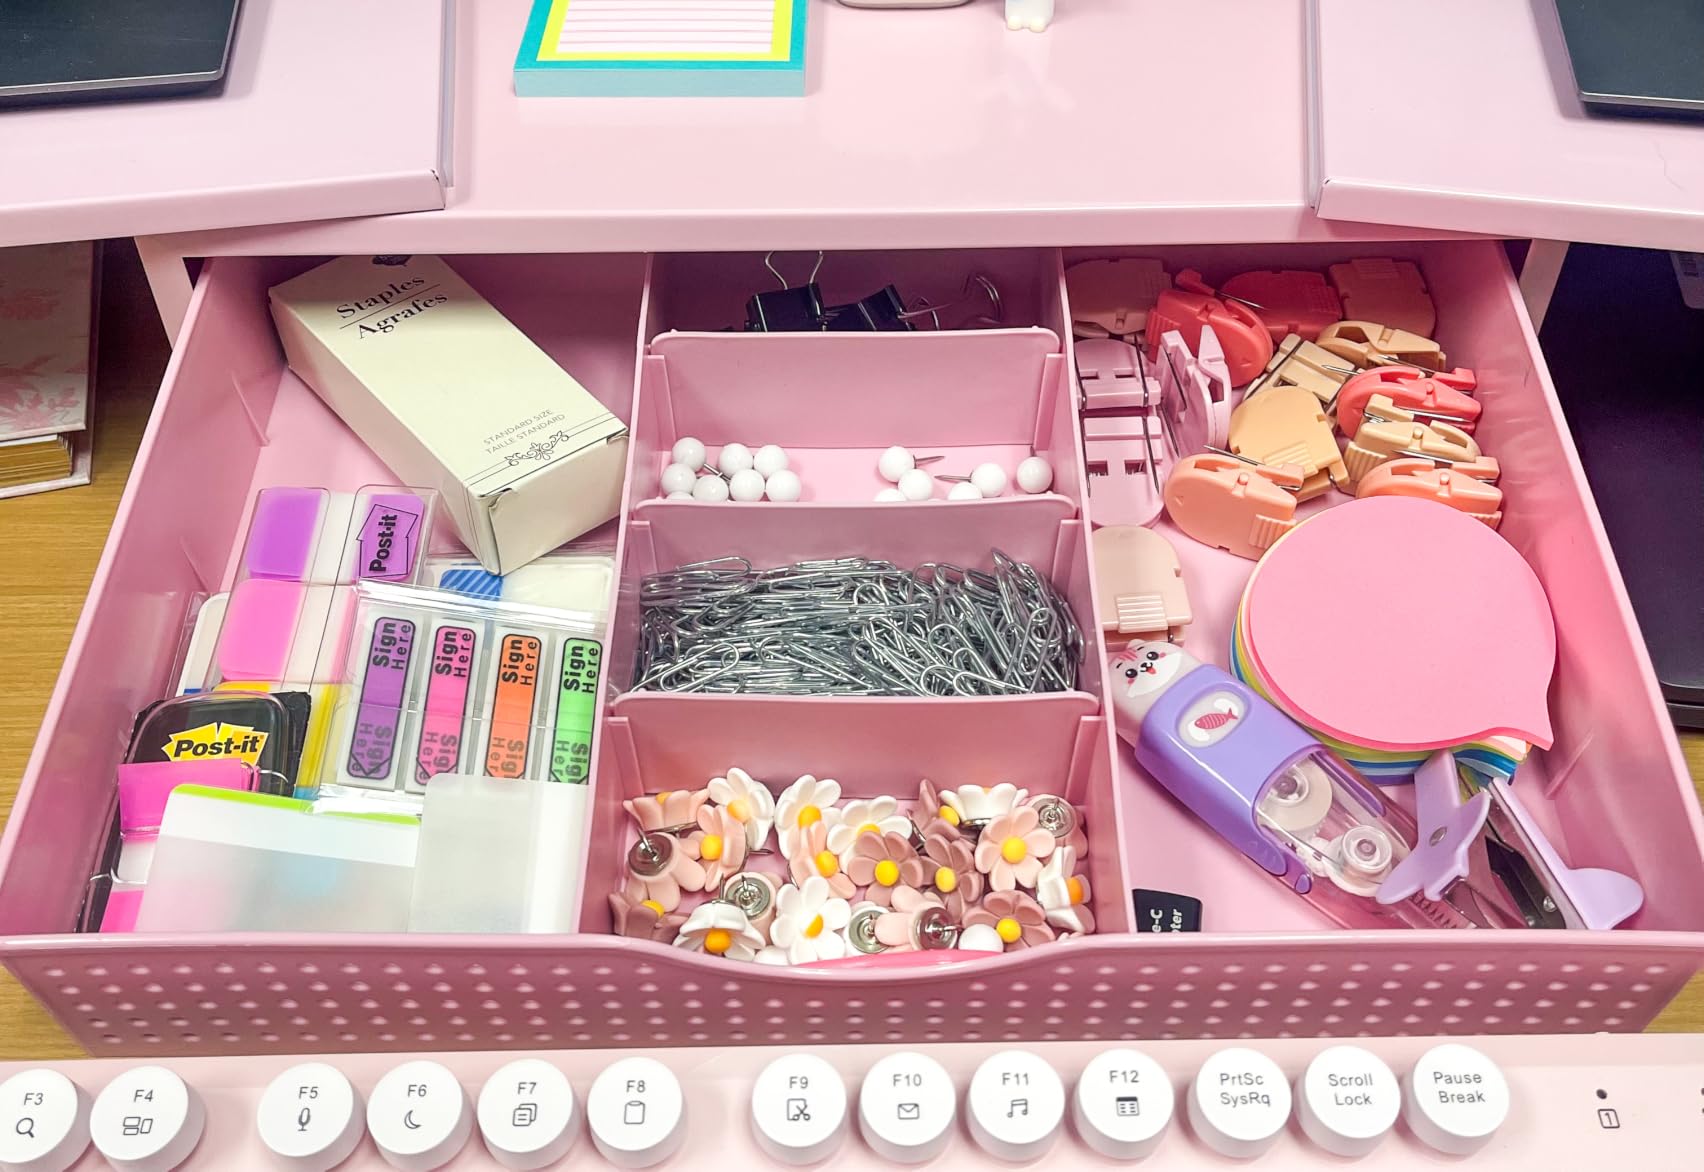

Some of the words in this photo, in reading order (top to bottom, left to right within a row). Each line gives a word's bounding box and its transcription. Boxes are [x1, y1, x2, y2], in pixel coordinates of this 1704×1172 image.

[336, 277, 425, 319] Staples
[359, 294, 448, 339] Agrafes
[483, 418, 533, 445] STANDARD
[533, 409, 553, 421] SIZE
[486, 437, 517, 454] TAILLE
[516, 413, 566, 440] STANDARD
[368, 514, 398, 572] Post-it
[373, 622, 397, 668] Sign
[391, 624, 411, 670] Here
[435, 631, 459, 676] Sign
[453, 633, 472, 678] Here
[502, 639, 525, 684] Sign
[520, 641, 538, 686] Here
[563, 645, 586, 692] Sign
[582, 647, 599, 694] Here
[174, 735, 260, 757] Post-it
[434, 735, 458, 773] Sig
[501, 739, 525, 778] Sig
[626, 1080, 646, 1093] F8
[789, 1076, 809, 1089] F9
[893, 1074, 922, 1087] F10
[1002, 1072, 1029, 1085] F11
[1109, 1070, 1140, 1084] F12
[1220, 1072, 1264, 1086] PrtSc
[1328, 1073, 1373, 1087] Scroll
[1433, 1071, 1483, 1084] Pause
[133, 1089, 154, 1103] F4
[298, 1086, 319, 1099] F5
[407, 1084, 427, 1097] F6
[517, 1082, 537, 1095] F7
[1439, 1090, 1486, 1104] Break
[23, 1092, 44, 1106] F3
[1220, 1091, 1271, 1108] SysRq
[1335, 1093, 1372, 1106] Lock
